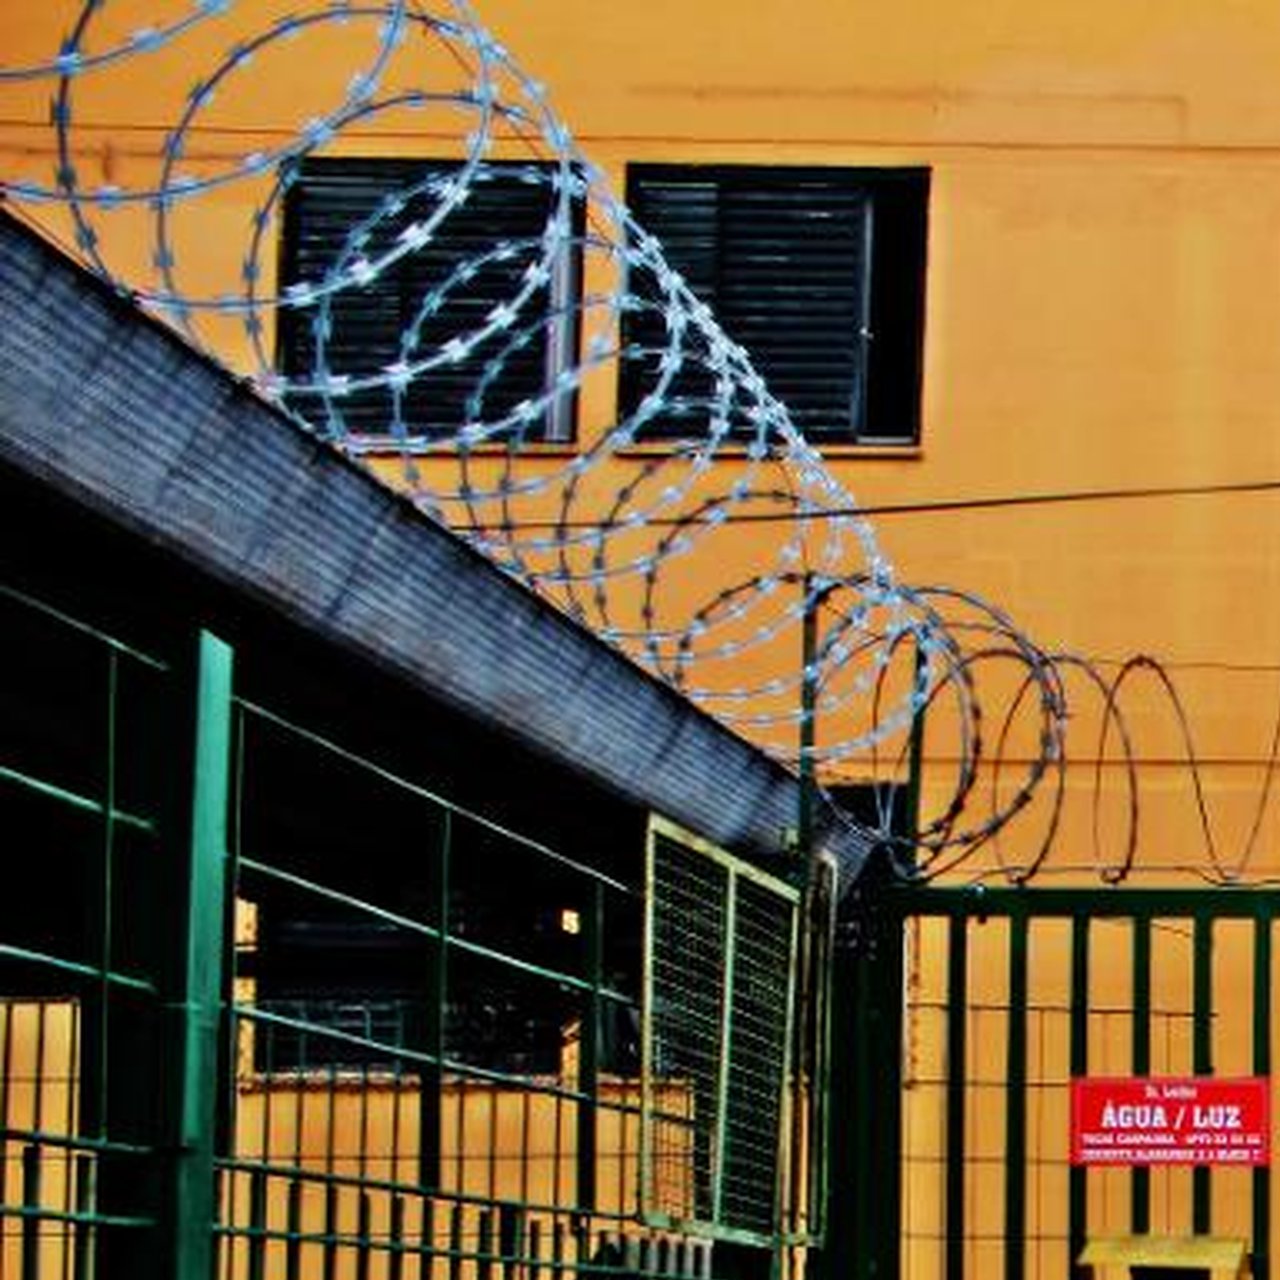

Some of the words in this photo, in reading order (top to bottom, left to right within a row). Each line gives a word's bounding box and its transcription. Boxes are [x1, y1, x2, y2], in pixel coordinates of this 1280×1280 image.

[1101, 1099, 1168, 1129] ÁGUA
[1173, 1105, 1187, 1131] /
[1192, 1105, 1243, 1129] LUZ
